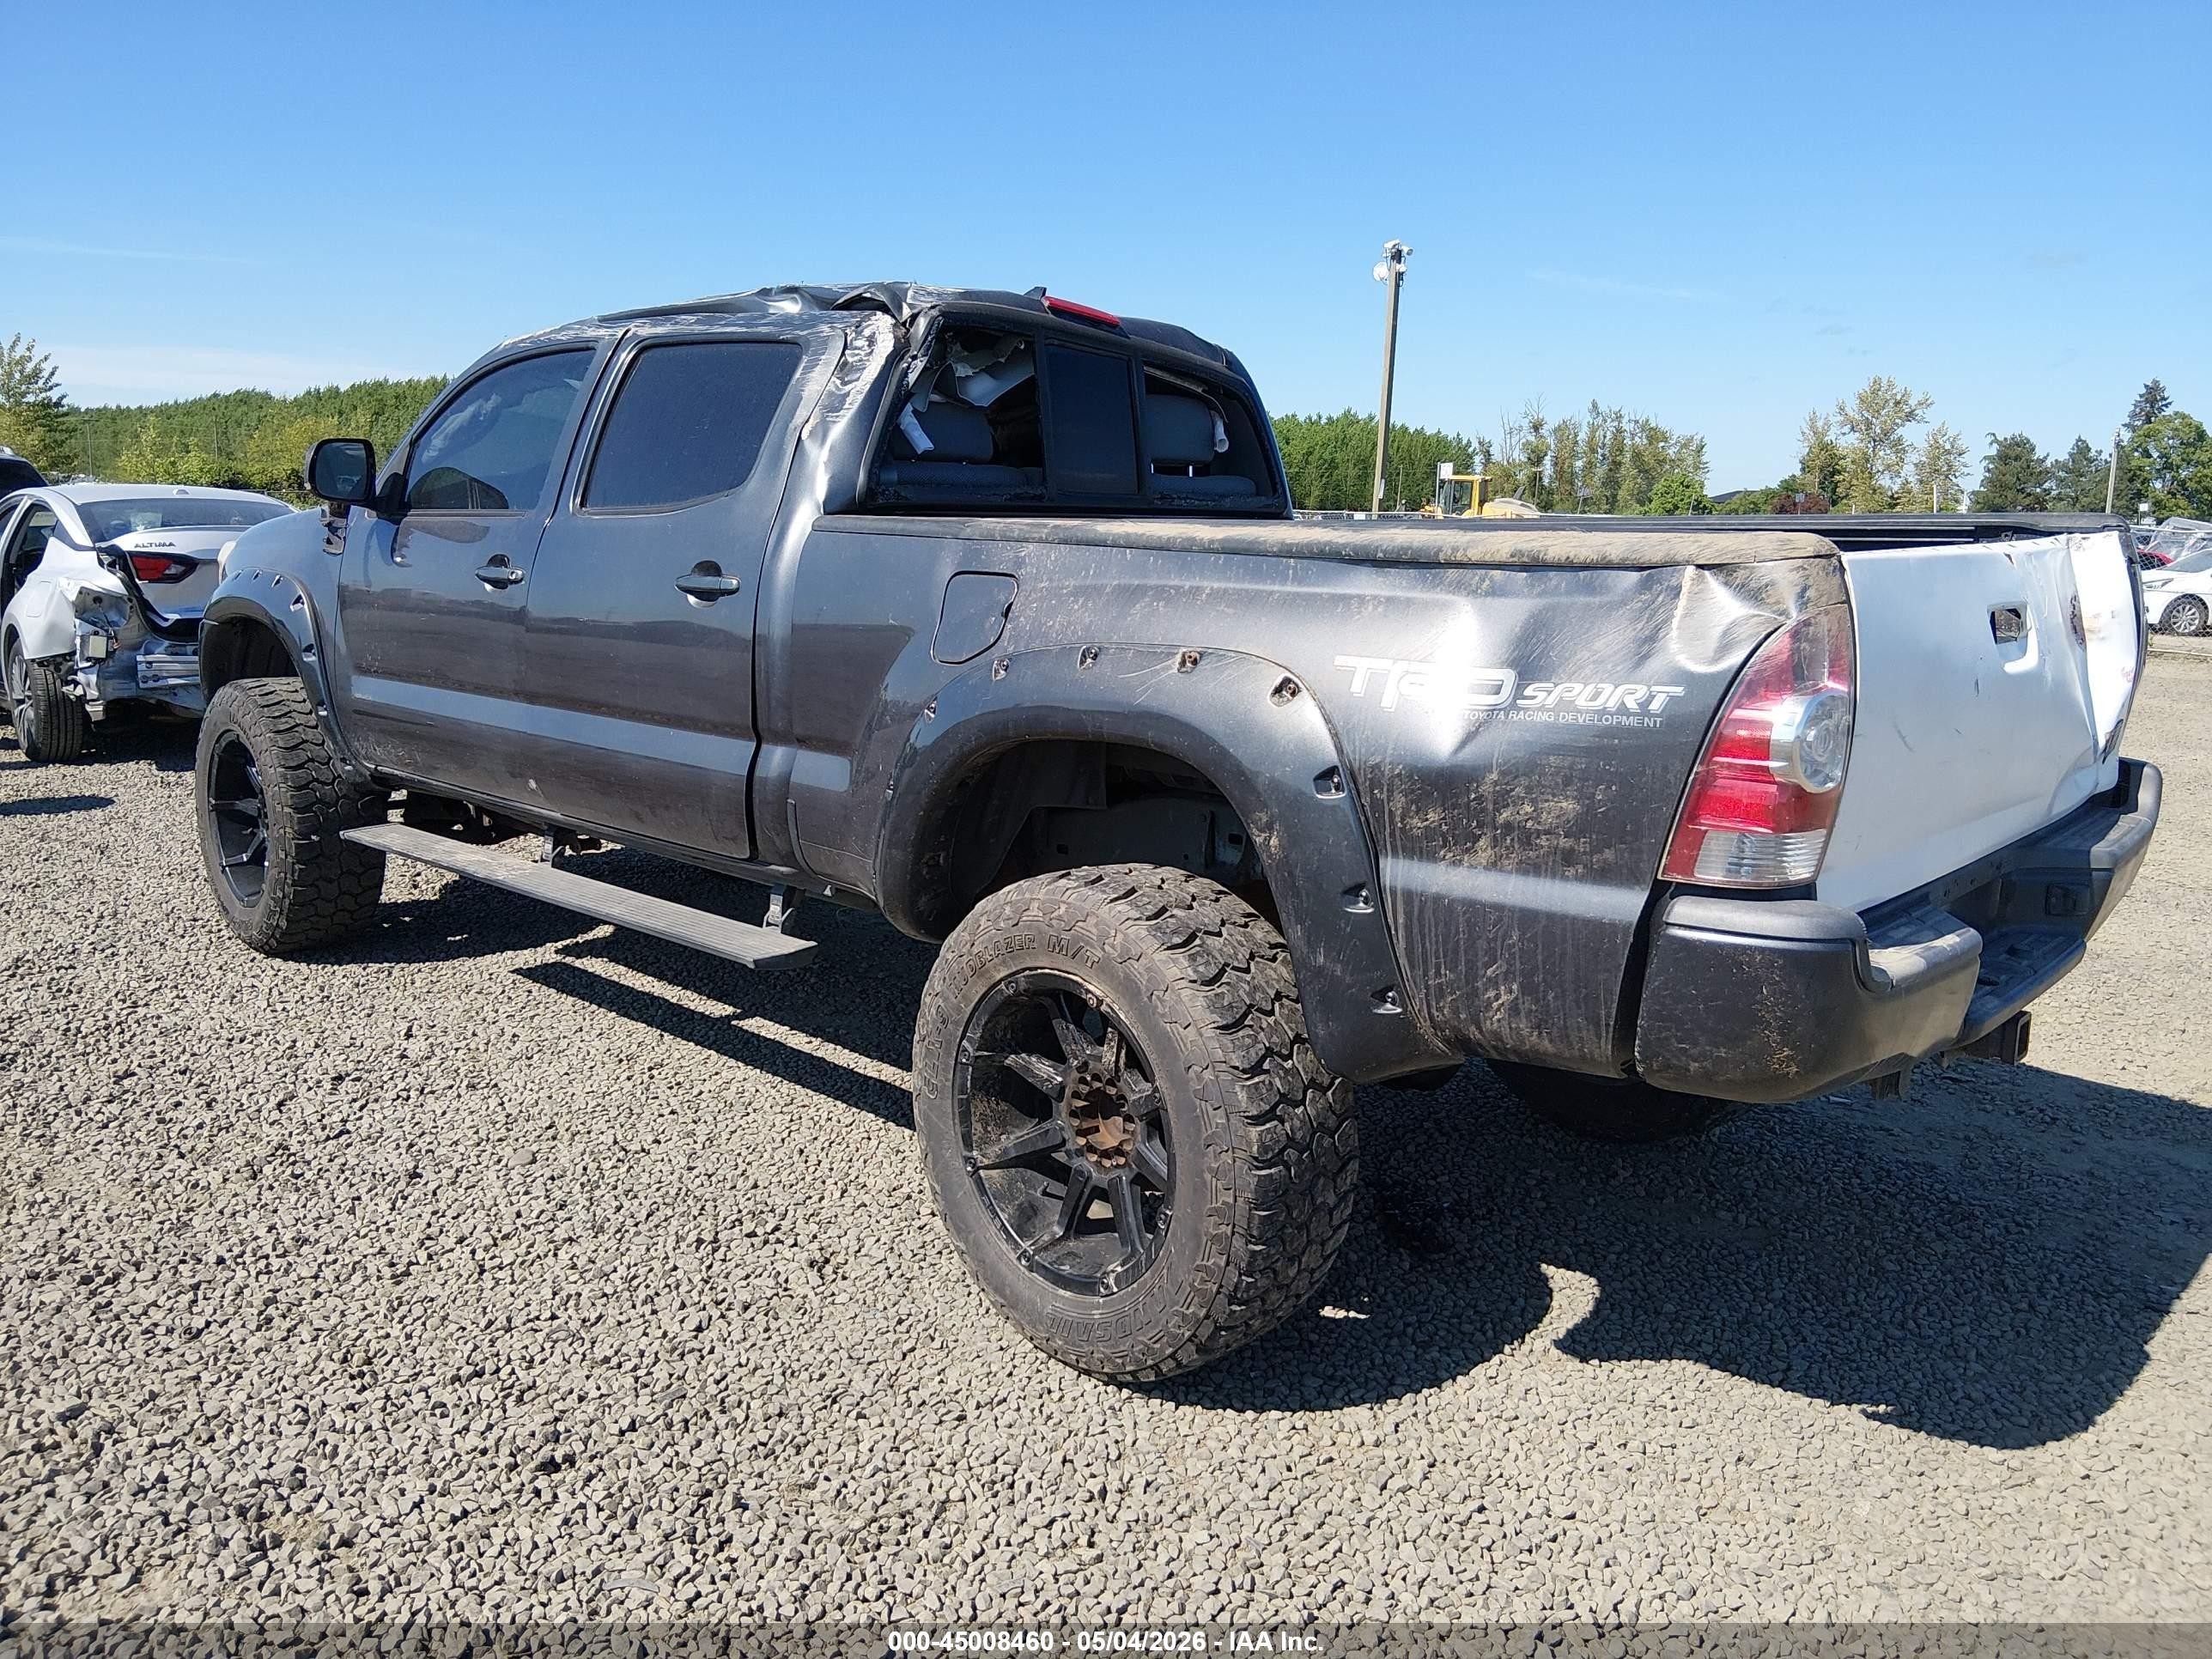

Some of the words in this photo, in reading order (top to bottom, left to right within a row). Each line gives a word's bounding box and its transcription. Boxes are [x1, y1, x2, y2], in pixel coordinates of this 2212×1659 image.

[1516, 681, 1685, 714] SPORT
[1463, 709, 1505, 721] TOYOTA
[1508, 710, 1554, 722] RACING
[1559, 712, 1663, 728] DEVELOPMENT
[947, 933, 1037, 1000] MUDBLAZER
[1047, 934, 1102, 969] M/T
